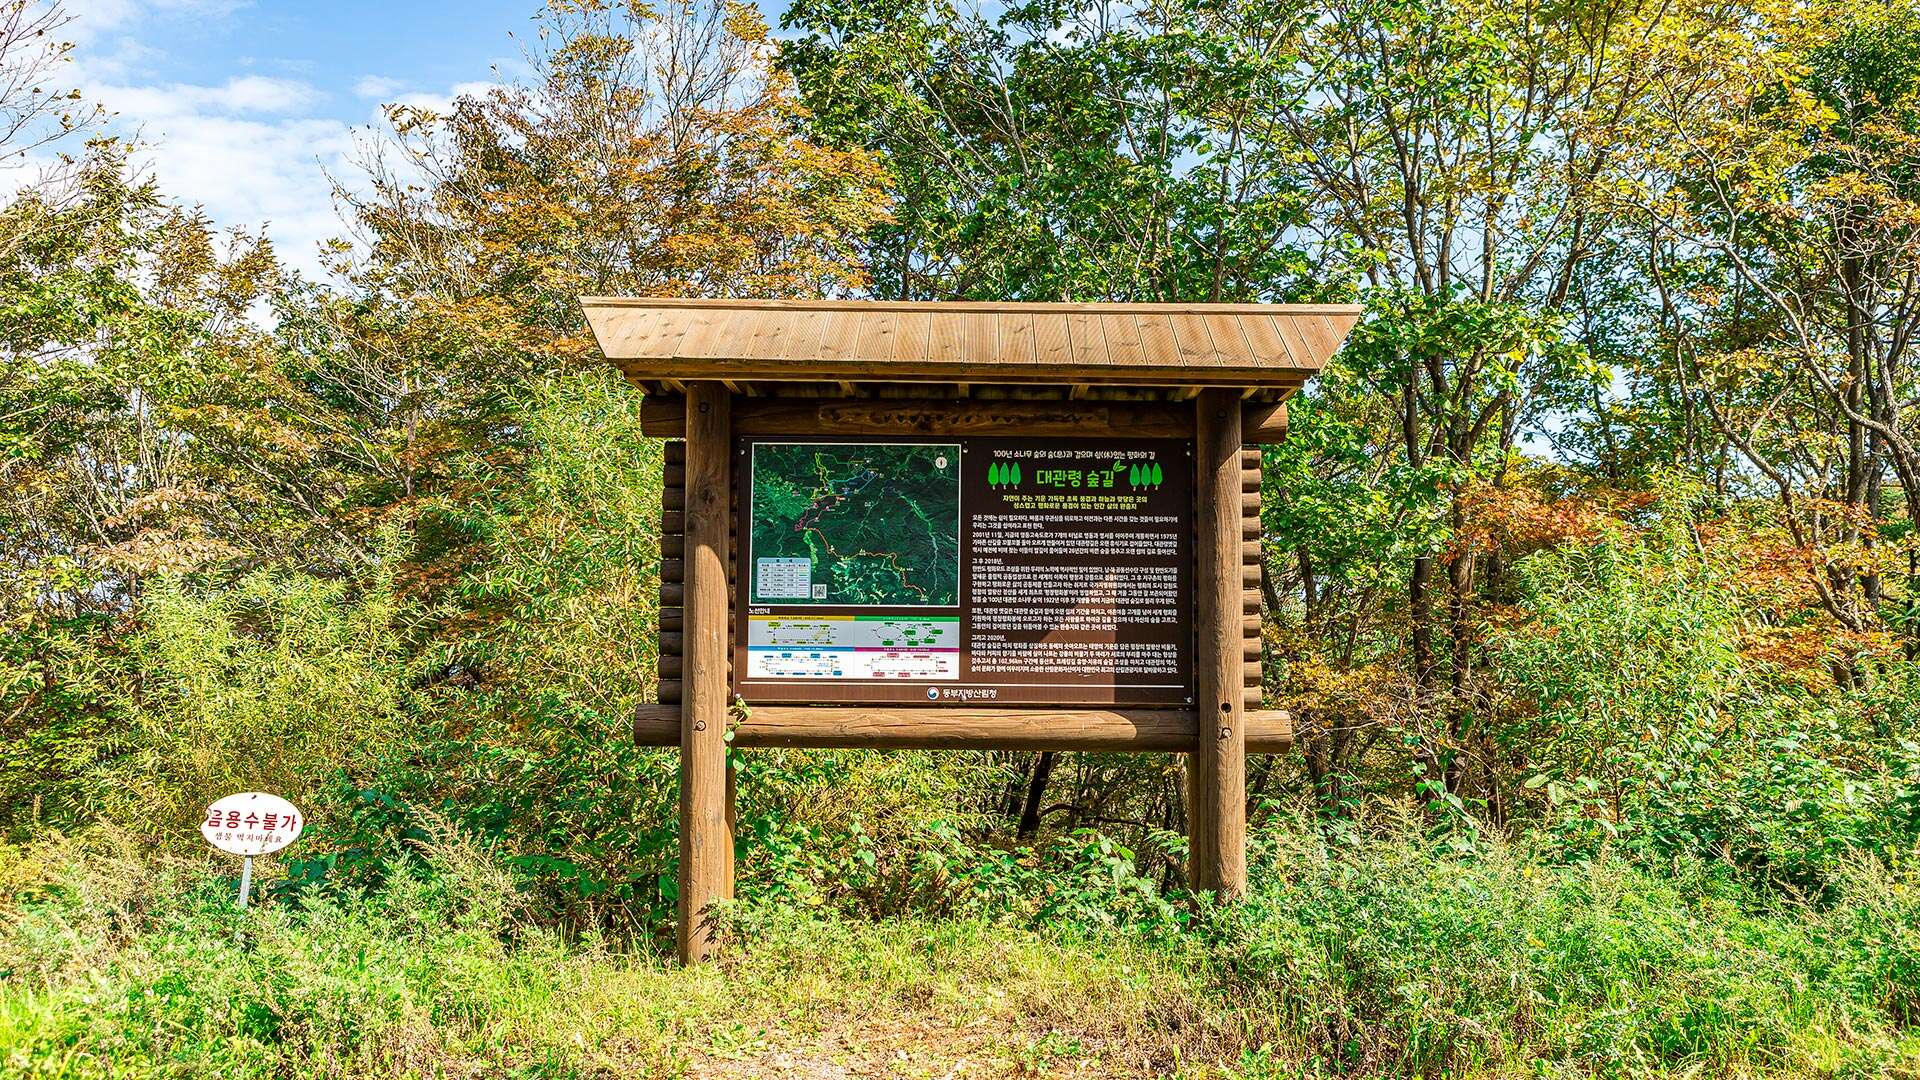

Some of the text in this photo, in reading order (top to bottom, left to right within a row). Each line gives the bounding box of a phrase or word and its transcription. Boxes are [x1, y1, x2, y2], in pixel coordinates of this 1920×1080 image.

[994, 451, 1012, 459] 100년
[1014, 451, 1032, 459] 소나무
[1037, 469, 1114, 487] 대관령 숲길
[943, 689, 997, 699] 동부지방산림청
